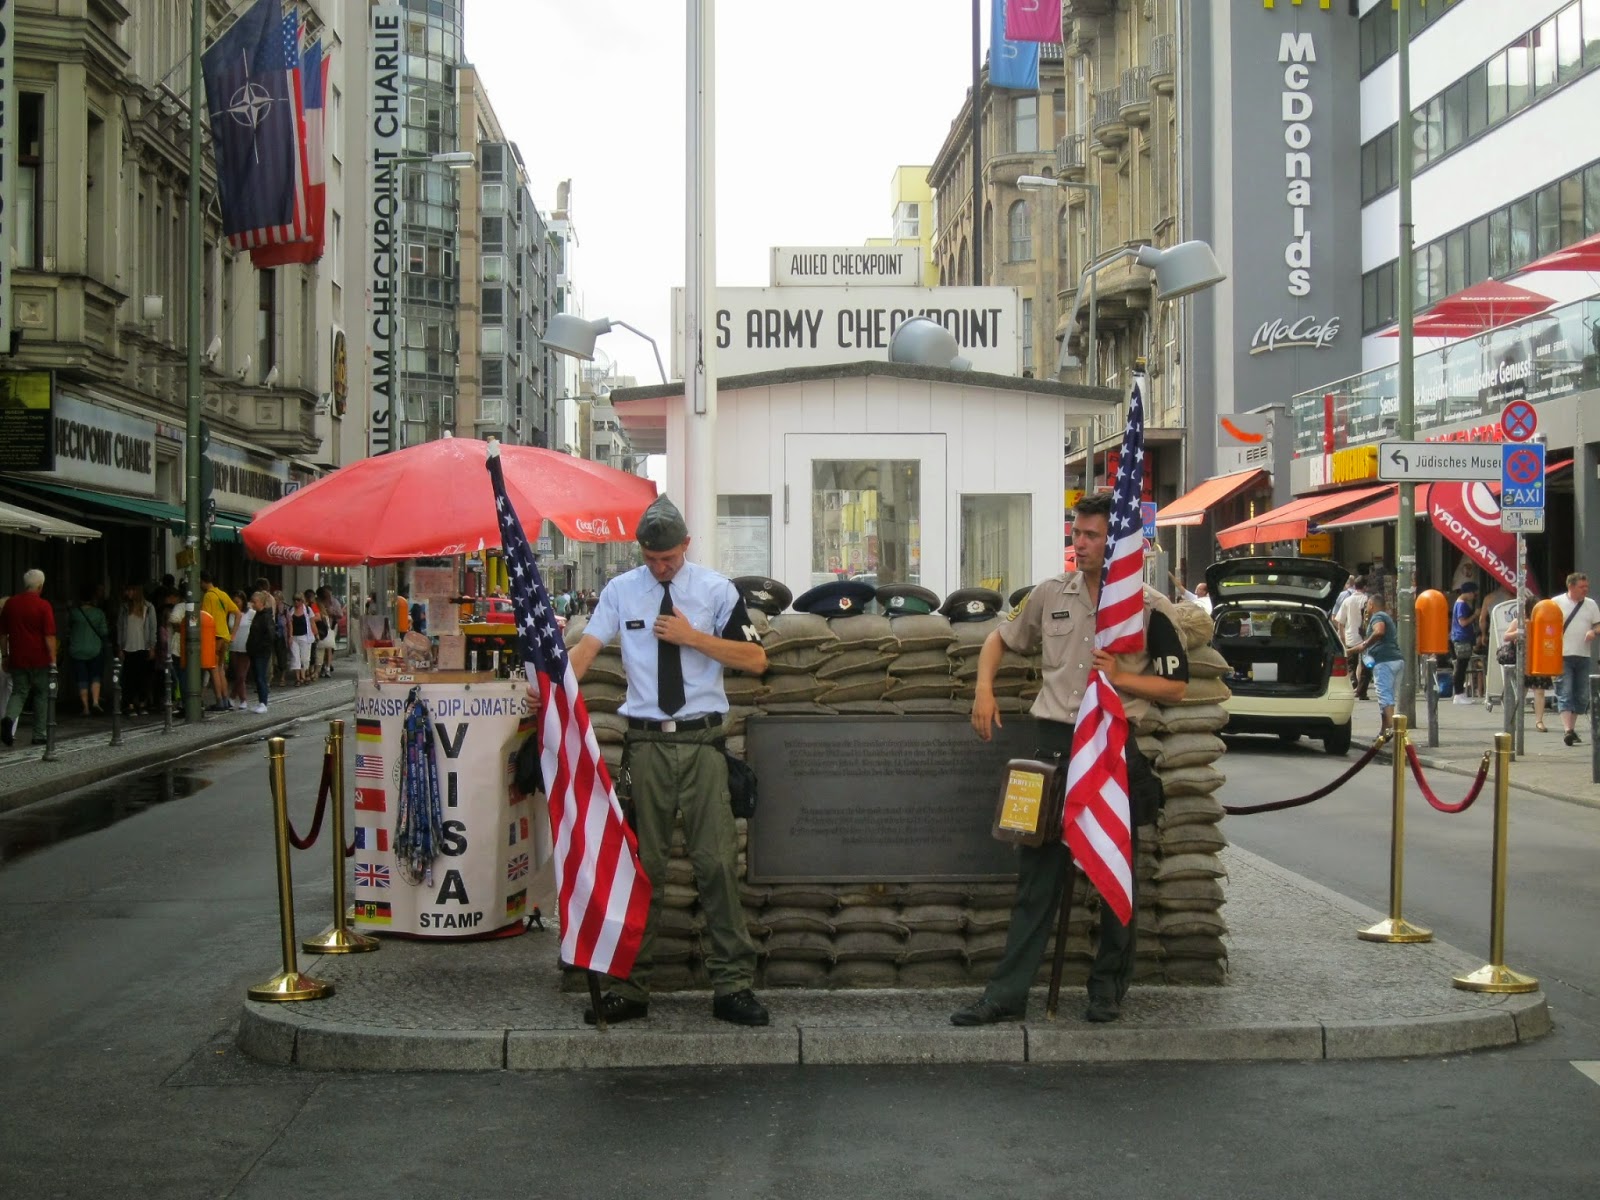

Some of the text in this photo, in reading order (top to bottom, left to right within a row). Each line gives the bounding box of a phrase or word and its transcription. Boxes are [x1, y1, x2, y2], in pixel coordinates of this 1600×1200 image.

[373, 16, 399, 138] CHARLIE
[1278, 32, 1316, 297] McDonalds
[373, 148, 398, 340] CHECKPOINT
[790, 253, 904, 275] ALLIED CHECKPOINT
[746, 308, 824, 349] ARMY
[837, 308, 1002, 349] CHECOINT
[373, 351, 397, 397] AM
[114, 432, 152, 475] CHARLIE
[1415, 455, 1467, 469] Jüdisches
[1505, 488, 1540, 502] TAXI
[419, 911, 484, 929] STAMP
